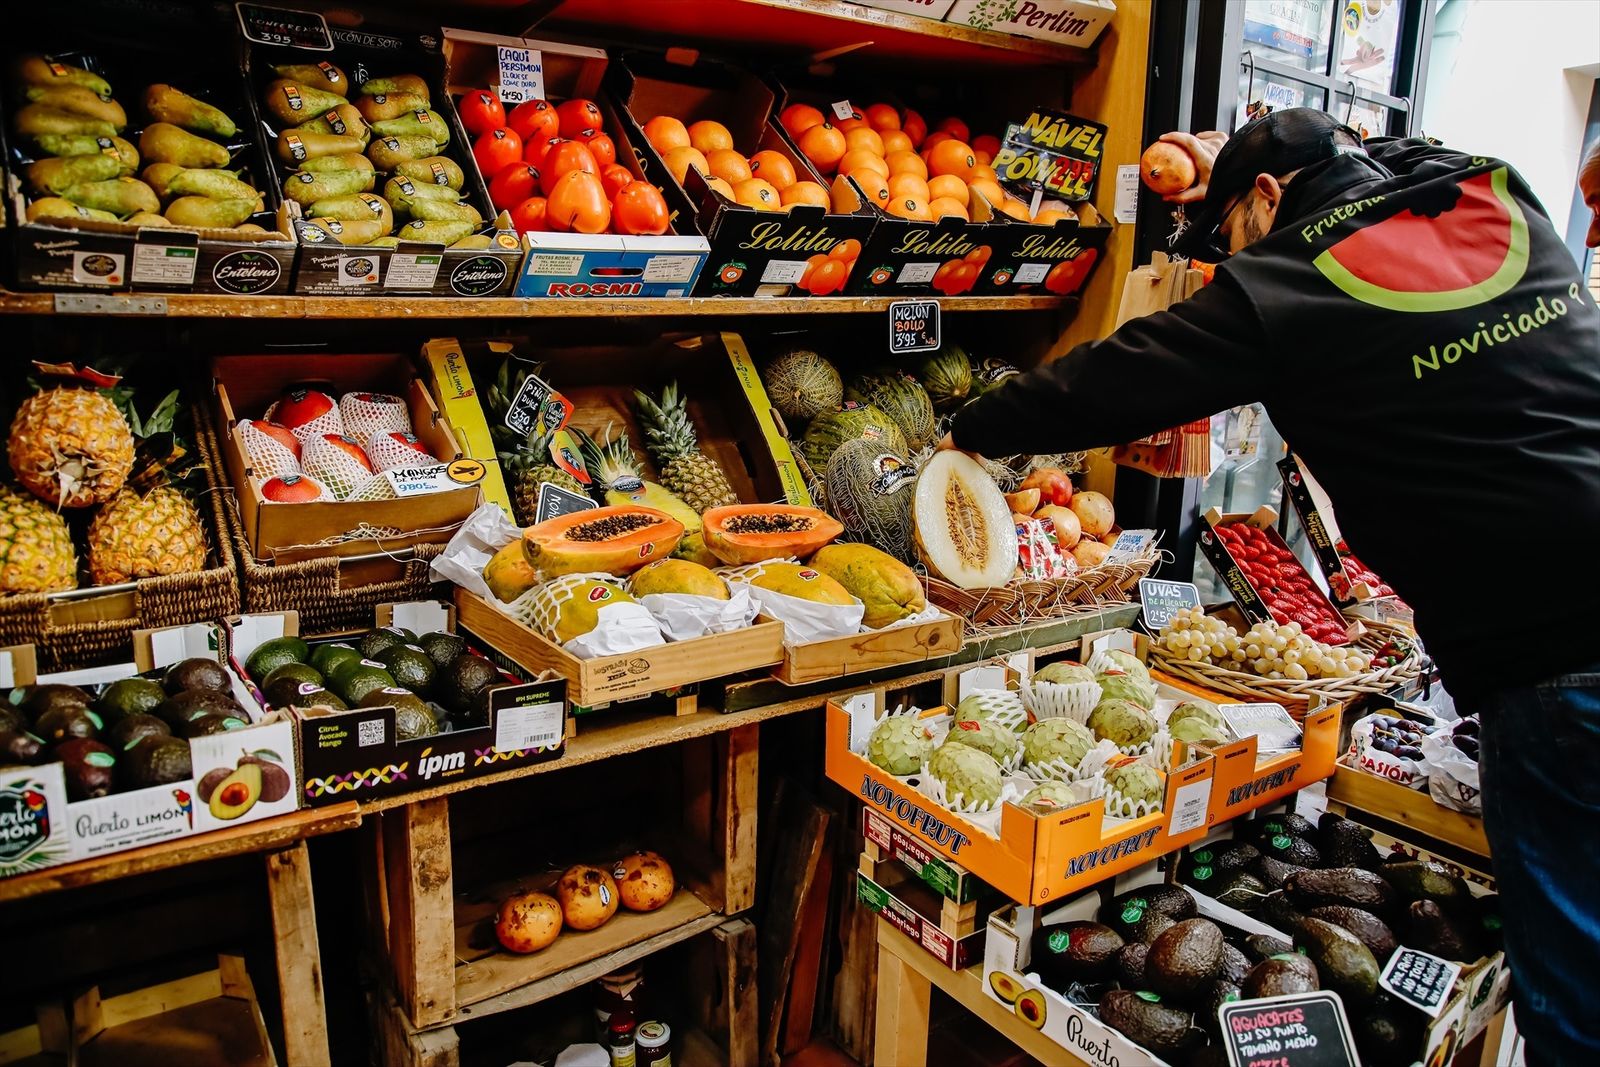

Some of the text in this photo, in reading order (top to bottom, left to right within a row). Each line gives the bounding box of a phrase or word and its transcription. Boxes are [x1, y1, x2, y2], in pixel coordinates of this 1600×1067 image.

[1011, 1, 1091, 37] Perlim
[330, 29, 361, 43] INCÓN
[363, 36, 377, 45] DE
[1019, 113, 1103, 158] NÁVEL
[739, 222, 841, 251] Lolita
[891, 229, 977, 255] Lolita
[1012, 234, 1084, 259] Lolita
[548, 283, 643, 297] ROSMI
[1412, 296, 1567, 379] Noviciado
[392, 465, 447, 479] MANGOS
[1307, 513, 1327, 549] Miguel
[1148, 583, 1181, 597] UVAS
[1227, 569, 1250, 605] Miguel
[526, 691, 550, 701] SUPREME
[319, 725, 339, 733] Citrus
[319, 731, 348, 740] Avocado
[319, 740, 342, 748] Mango
[418, 747, 466, 780] ipm
[1226, 764, 1299, 807] NOVOFRUT
[76, 808, 184, 838] Puerto LIMÓN
[861, 775, 966, 855] NOVOFRUT
[892, 832, 931, 865] Sabariego
[1064, 826, 1160, 880] NOVOFRUT
[882, 905, 920, 938] Sabariego
[1402, 977, 1416, 993] NO
[1231, 1008, 1304, 1033] AGUACATES
[1237, 1023, 1307, 1044] EN SU PUNTO
[1067, 1015, 1120, 1067] Puerto
